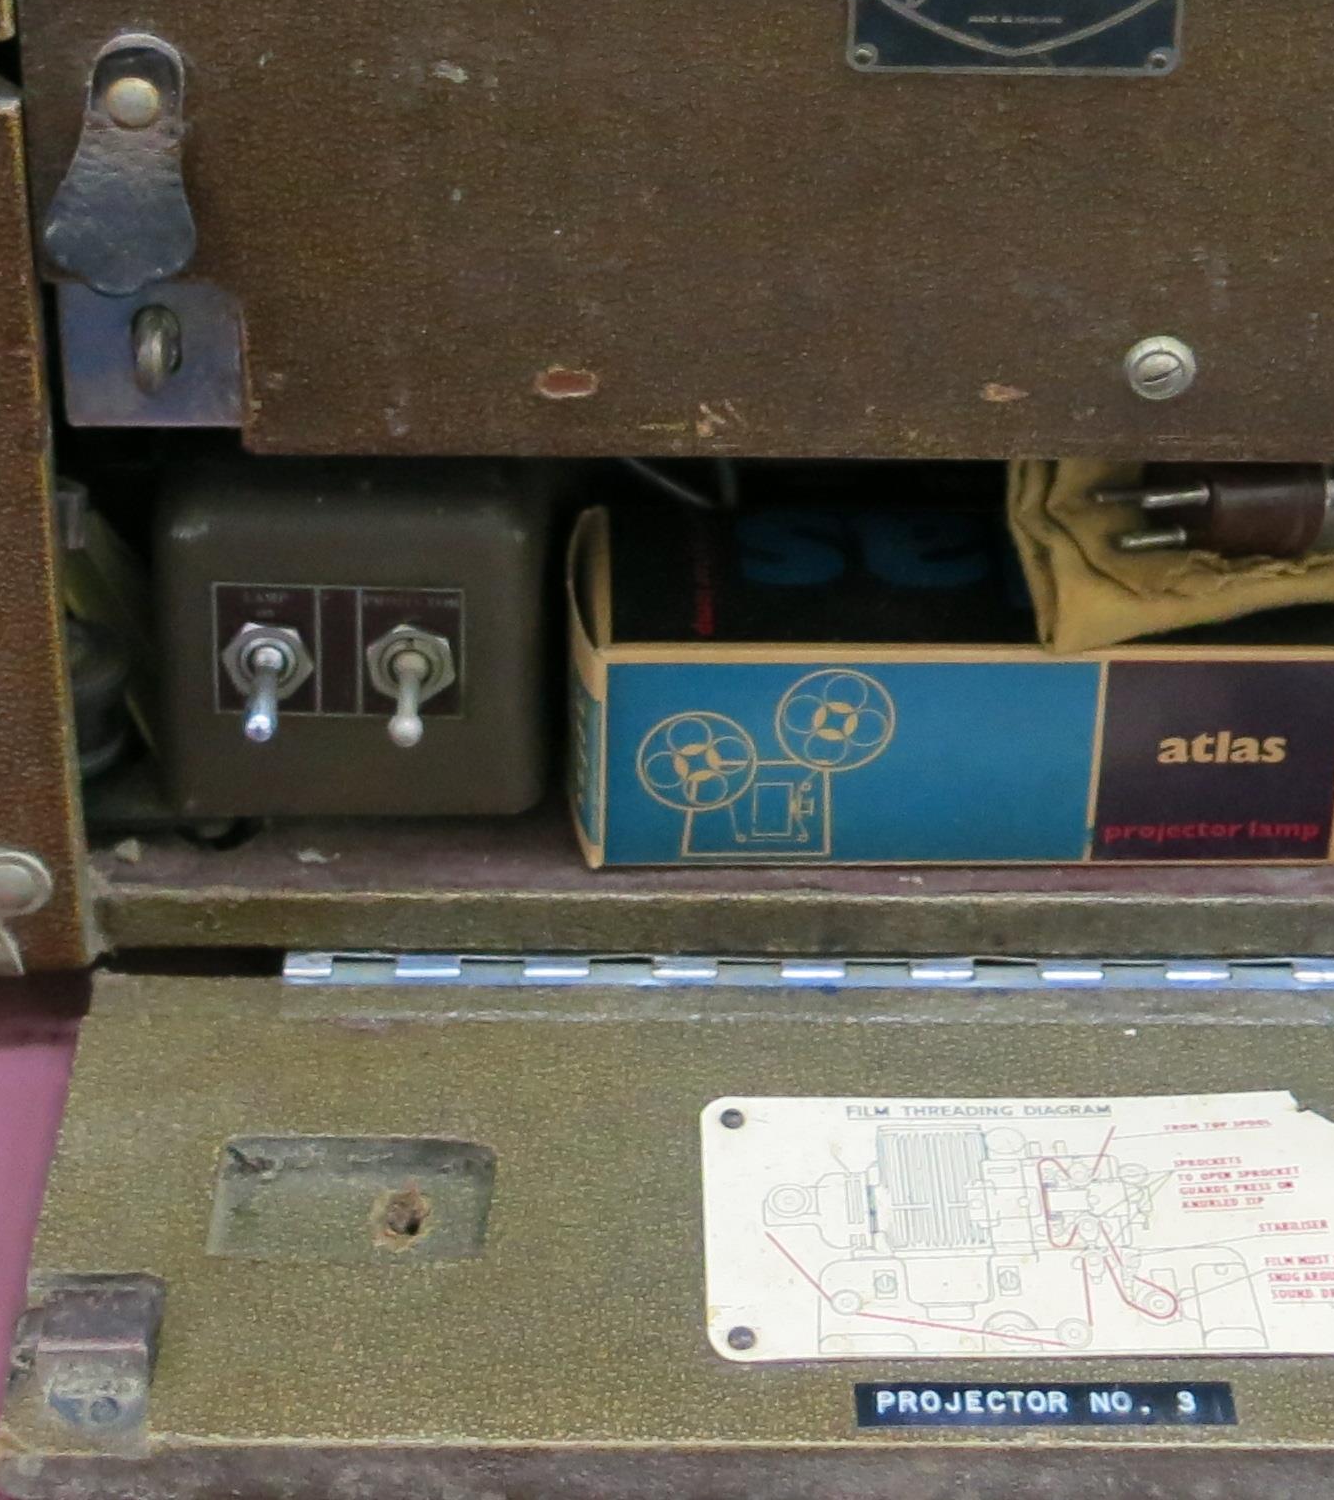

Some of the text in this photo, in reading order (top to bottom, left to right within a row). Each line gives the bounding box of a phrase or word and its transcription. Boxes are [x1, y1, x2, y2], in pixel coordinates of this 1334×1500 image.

[1157, 730, 1288, 763] atlas
[1102, 820, 1320, 843] projector lamp
[846, 1103, 1112, 1117] FILM THREADING DIAGRAM
[1173, 1156, 1242, 1168] SPROCKETS
[1177, 1166, 1300, 1182] TO OPEN SPROCKET
[1179, 1185, 1229, 1195] GUARDS
[1234, 1182, 1271, 1192] PRESS
[1258, 1220, 1329, 1233] STABILISER
[1298, 1254, 1330, 1265] MUST
[875, 1390, 1069, 1415] PROJECTOR
[1089, 1390, 1152, 1415] NO.
